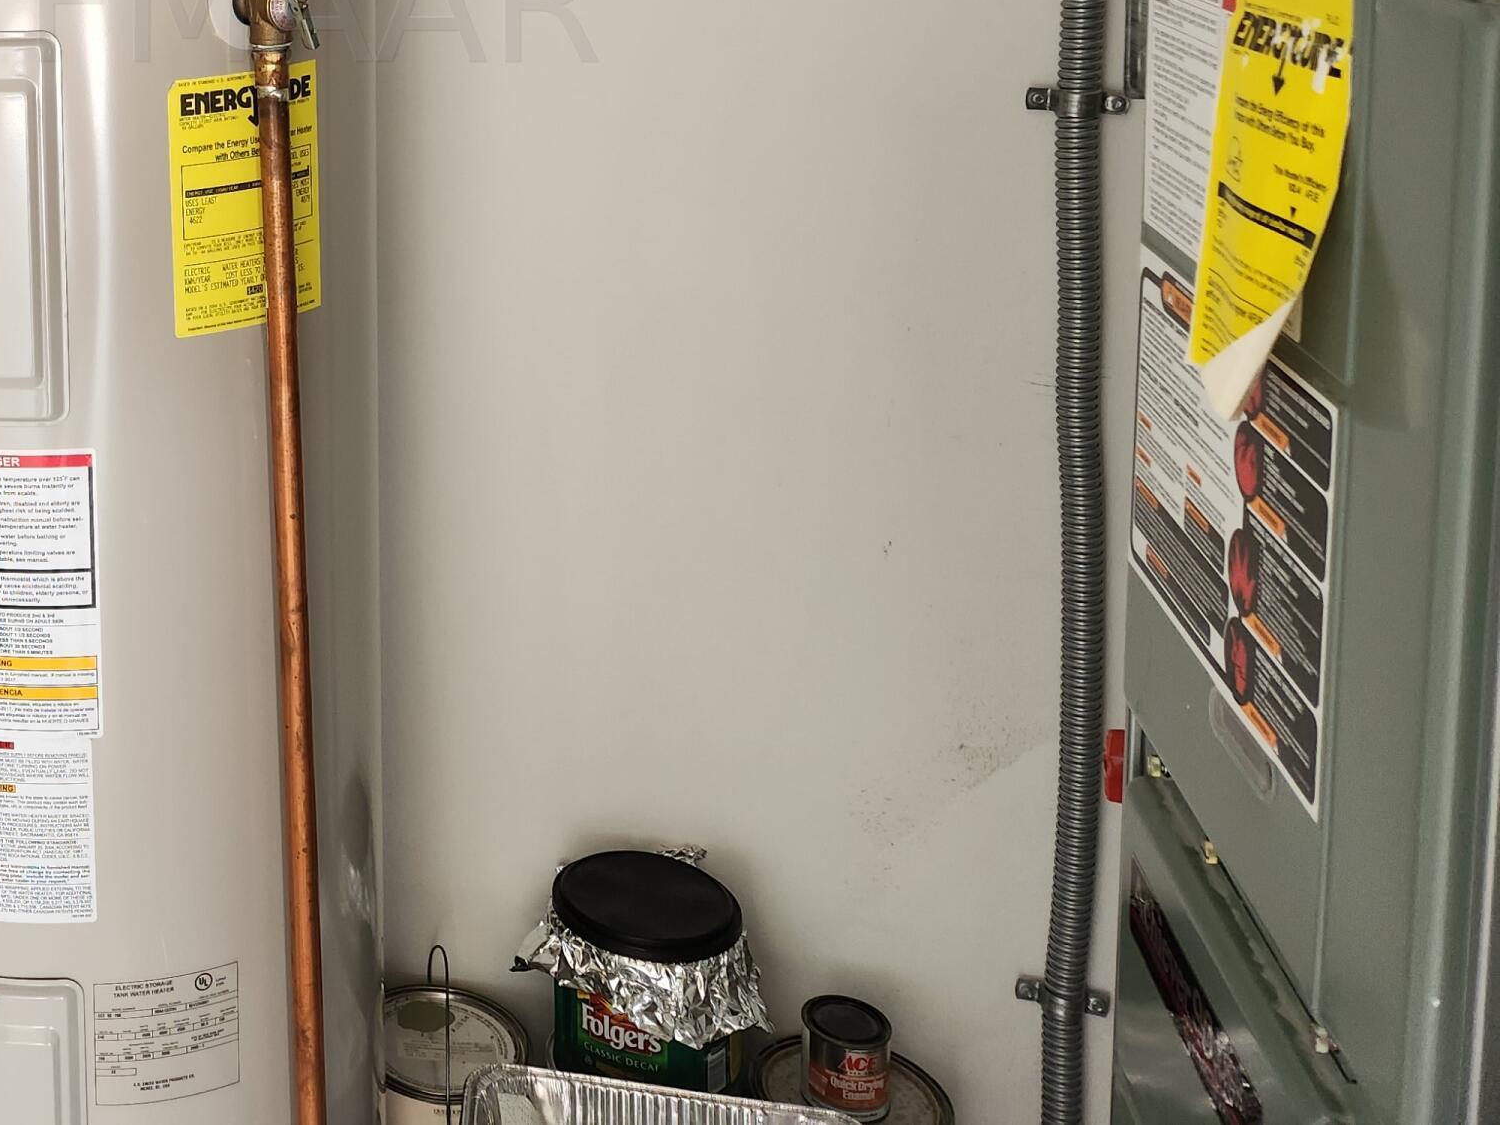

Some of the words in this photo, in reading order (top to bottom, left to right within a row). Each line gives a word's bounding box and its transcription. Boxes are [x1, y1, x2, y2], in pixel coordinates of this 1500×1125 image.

[182, 142, 213, 154] Compare
[215, 139, 225, 150] the
[226, 138, 249, 150] Energy
[215, 151, 229, 162] with
[229, 149, 250, 160] Others
[185, 198, 200, 208] USES
[201, 196, 217, 206] LEAST
[185, 206, 205, 216] ENERGY
[189, 216, 203, 224] 4622
[184, 266, 211, 277] ELECTRIC
[222, 262, 238, 271] WATER
[240, 258, 261, 269] HEATERS
[184, 275, 211, 285] KWH/YEAR
[225, 271, 238, 280] COST
[240, 269, 253, 278] LESS
[255, 266, 261, 274] TO
[210, 279, 239, 291] ESTIMATED
[240, 276, 259, 286] YEARLY
[115, 982, 143, 991] ELECTRIC
[145, 979, 173, 989] STORAGE
[151, 986, 175, 996] HEATER
[581, 1002, 662, 1053] Folgers
[583, 1041, 621, 1064] CLASSIC
[837, 1056, 876, 1072] ACE
[830, 1076, 857, 1091] Quick
[858, 1078, 885, 1092] Drying
[842, 1089, 876, 1100] Enamel
